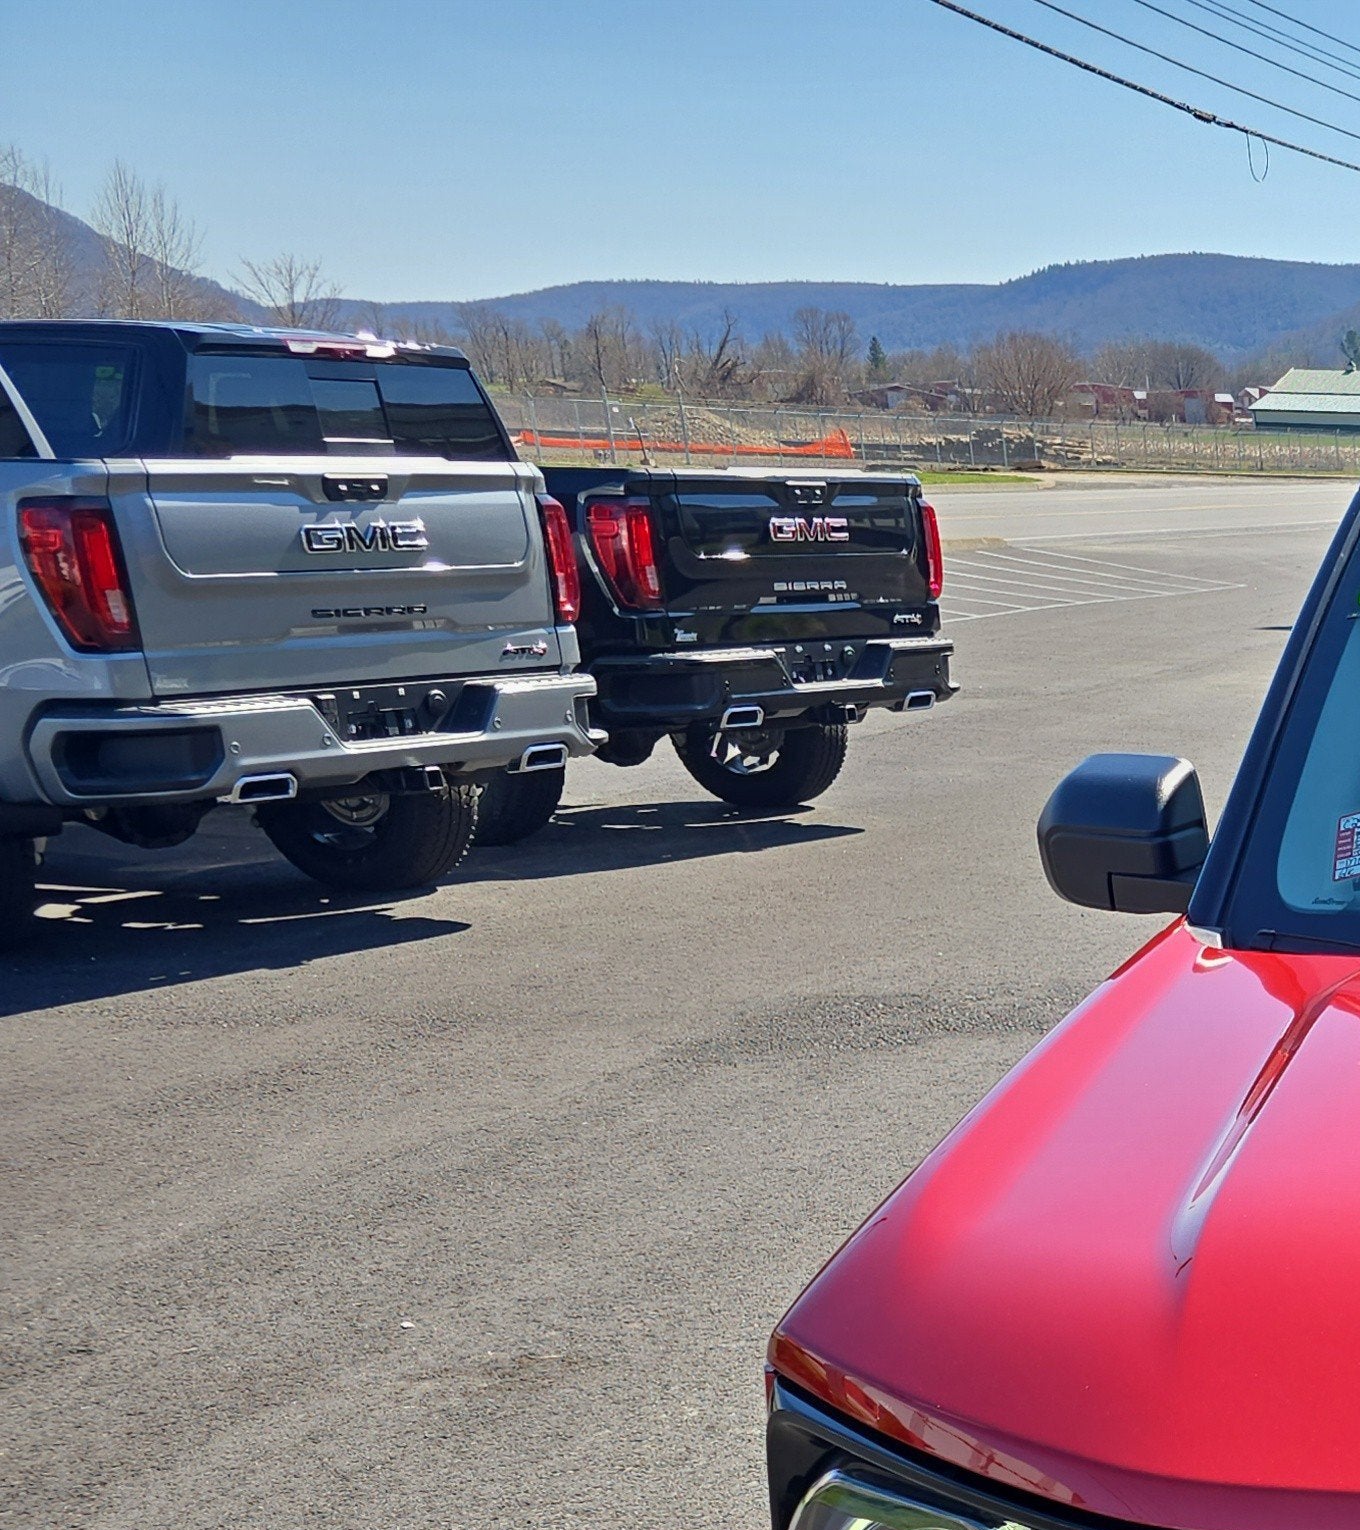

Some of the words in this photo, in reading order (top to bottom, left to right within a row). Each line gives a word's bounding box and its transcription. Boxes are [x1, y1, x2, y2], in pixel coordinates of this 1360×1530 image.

[301, 520, 429, 554] GMC
[769, 517, 850, 542] GMC
[774, 580, 848, 591] SIERRA
[311, 604, 428, 619] SIERRA
